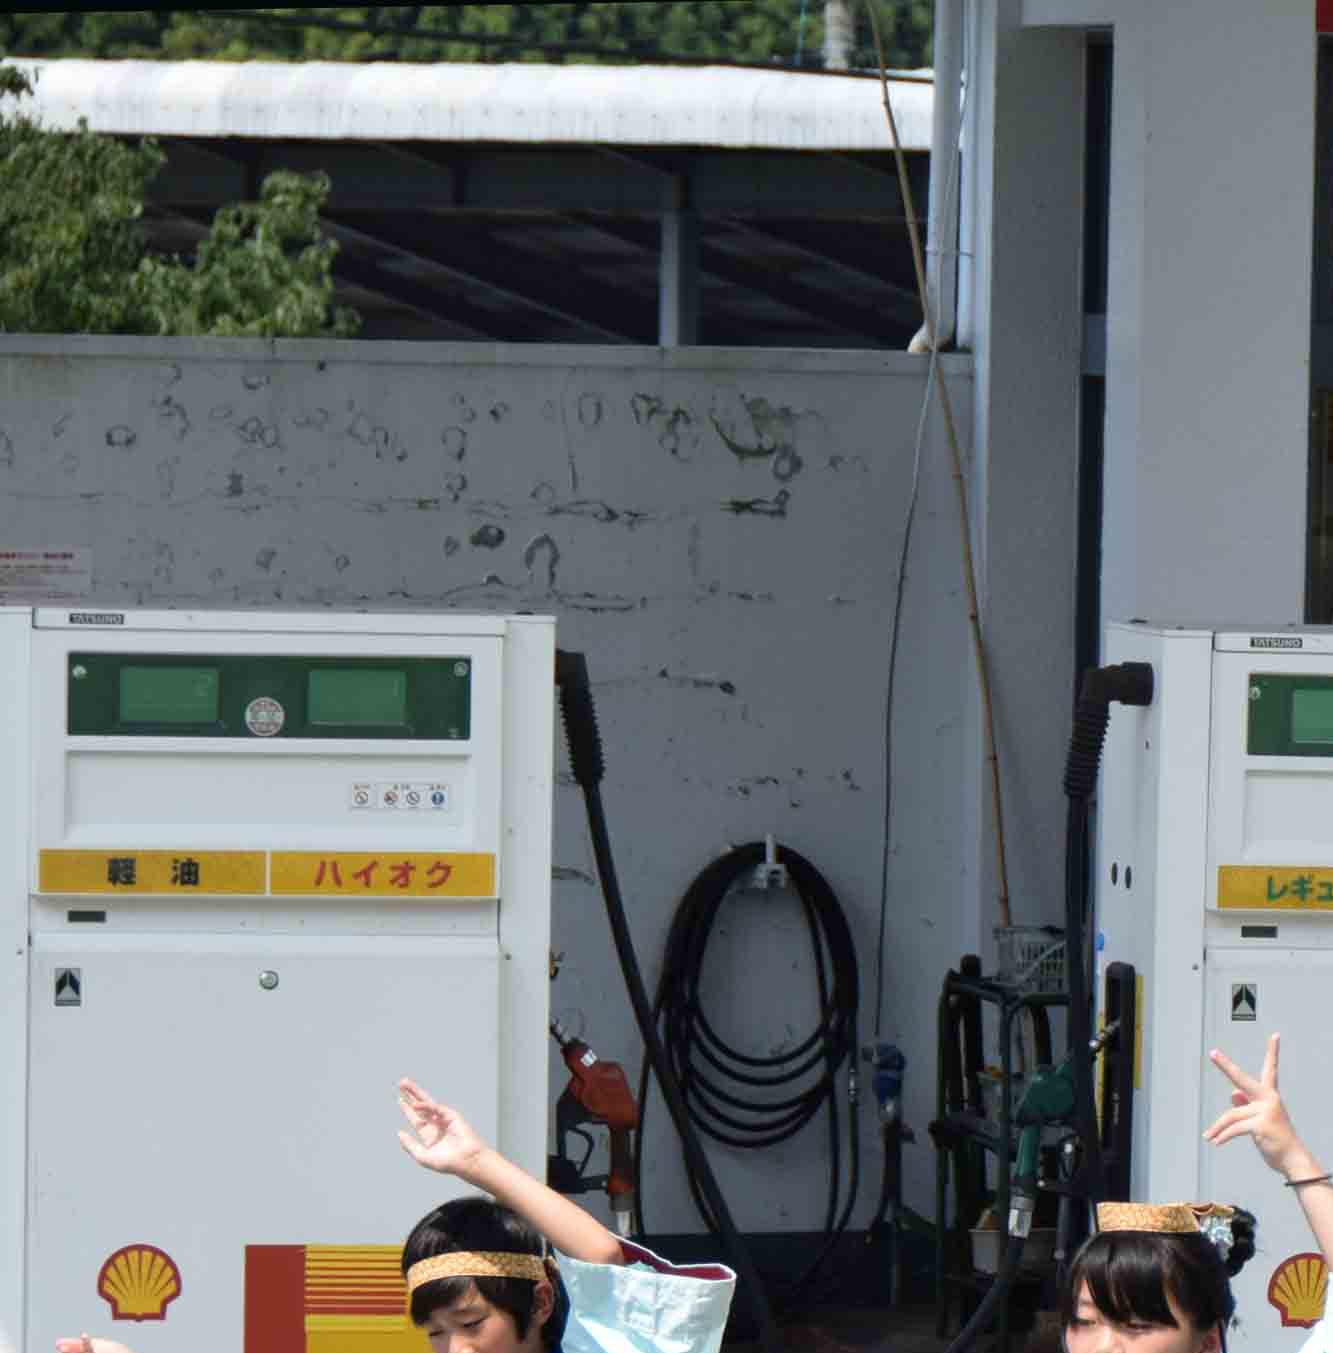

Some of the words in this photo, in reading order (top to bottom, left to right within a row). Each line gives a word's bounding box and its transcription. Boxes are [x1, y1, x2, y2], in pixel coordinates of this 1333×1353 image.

[106, 857, 201, 887] 軽油
[314, 859, 456, 888] ハイオク
